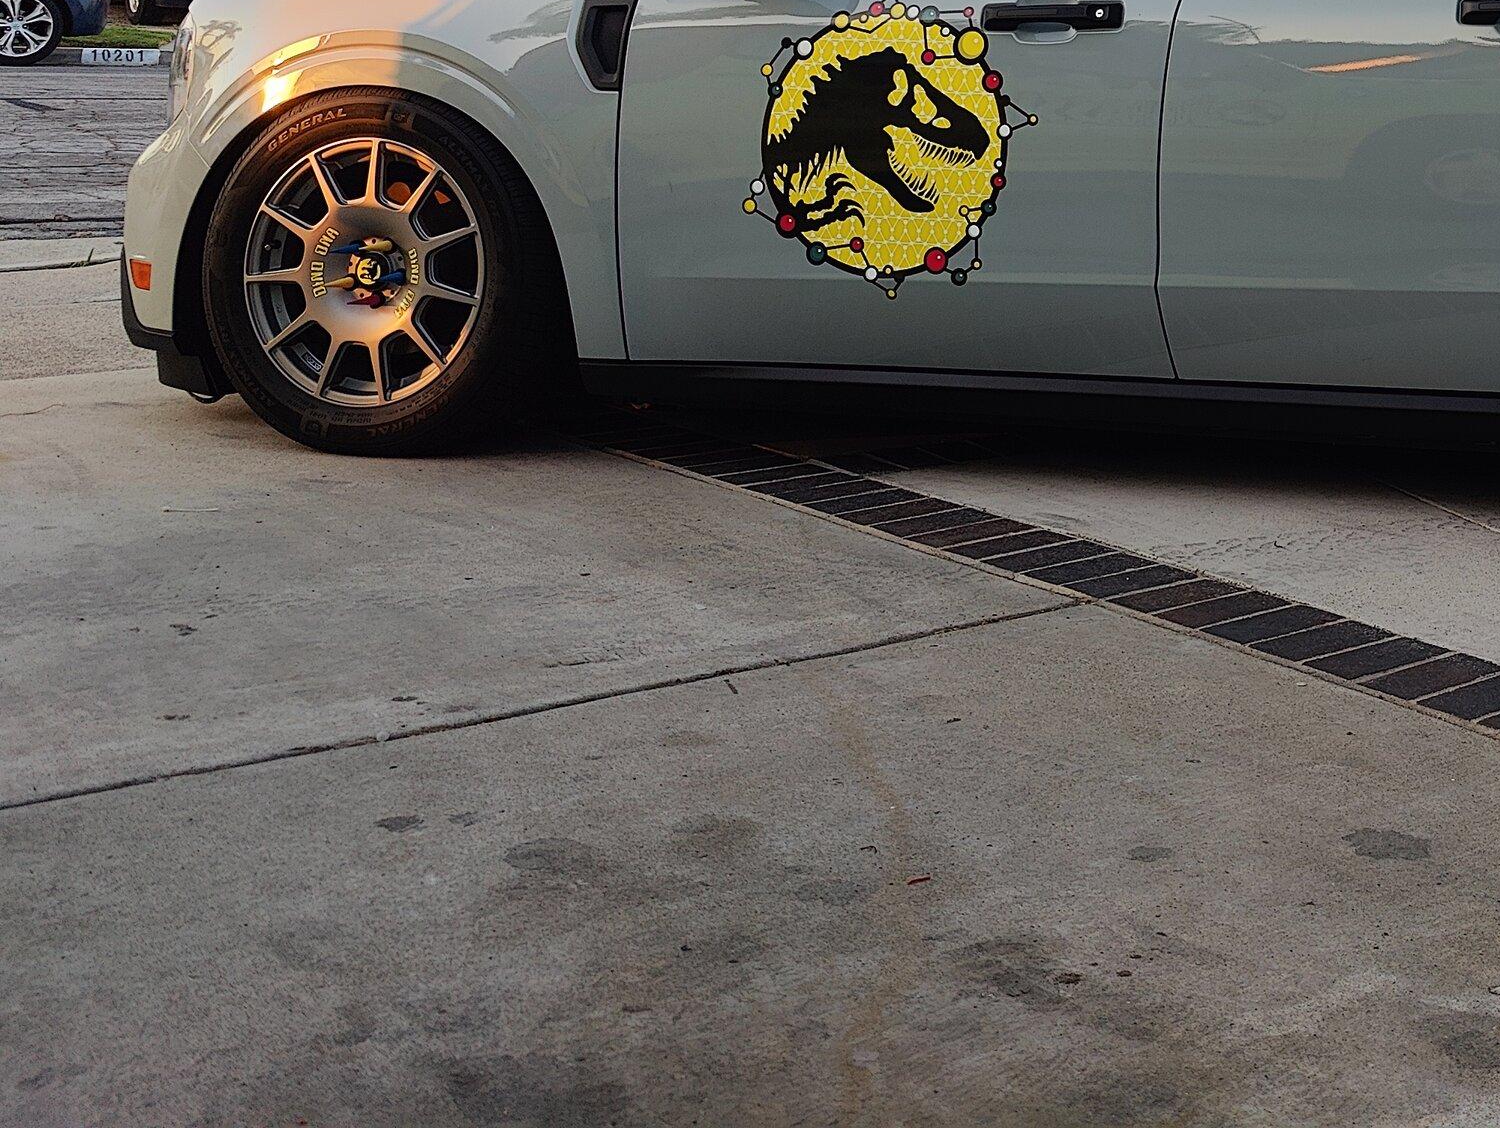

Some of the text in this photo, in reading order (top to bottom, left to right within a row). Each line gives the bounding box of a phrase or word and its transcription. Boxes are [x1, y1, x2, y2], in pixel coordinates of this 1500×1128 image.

[91, 49, 145, 62] 10201
[267, 108, 348, 152] GENERAL
[310, 227, 340, 298] DINO DNA
[407, 247, 420, 285] DINO
